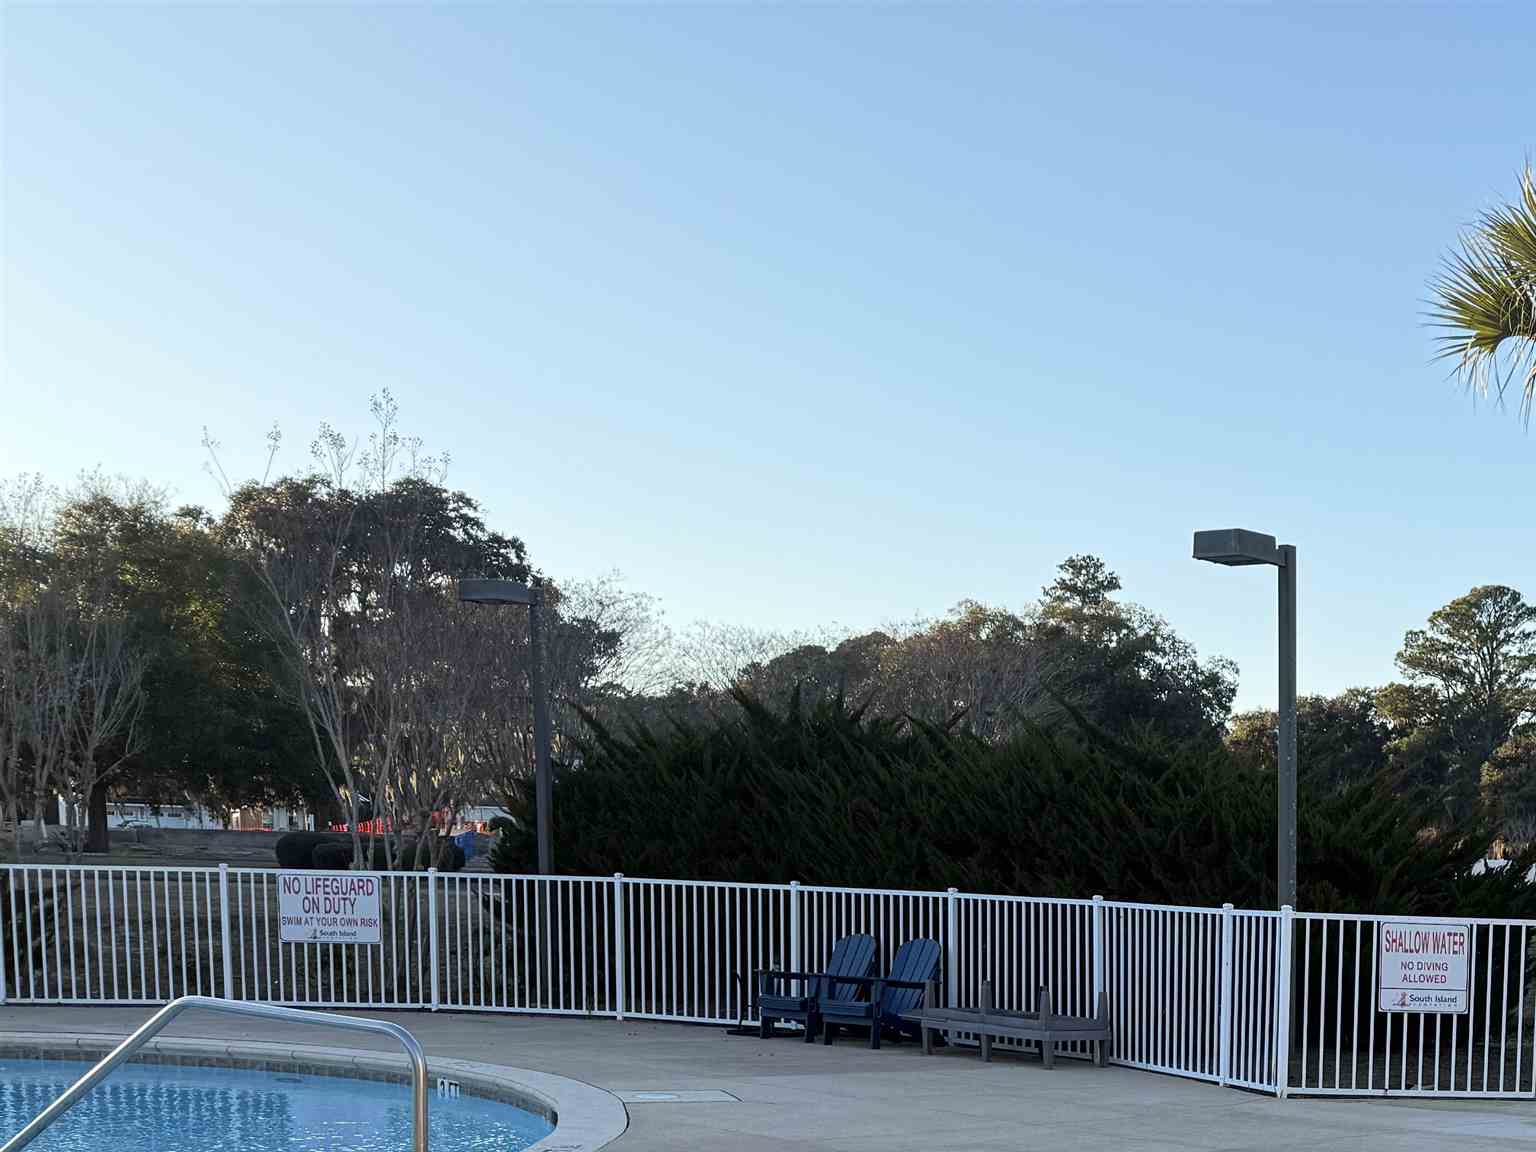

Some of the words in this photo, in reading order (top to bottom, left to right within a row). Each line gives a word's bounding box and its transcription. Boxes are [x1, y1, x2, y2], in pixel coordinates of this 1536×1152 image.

[283, 877, 301, 895] NO
[305, 878, 374, 896] LIFEGUARD
[303, 896, 320, 913] ON
[324, 897, 356, 914] DUTY
[282, 916, 304, 925] SWIM
[305, 917, 316, 926] AT
[317, 918, 337, 926] YOUR
[340, 918, 358, 927] OWN
[360, 918, 378, 927] RISK
[1385, 930, 1430, 953] SHALLOW
[1432, 932, 1465, 955] WATER
[1401, 962, 1414, 970] NO
[1417, 962, 1448, 971] DIVING
[1401, 975, 1446, 983] ALLOWED
[1409, 994, 1432, 1002] South
